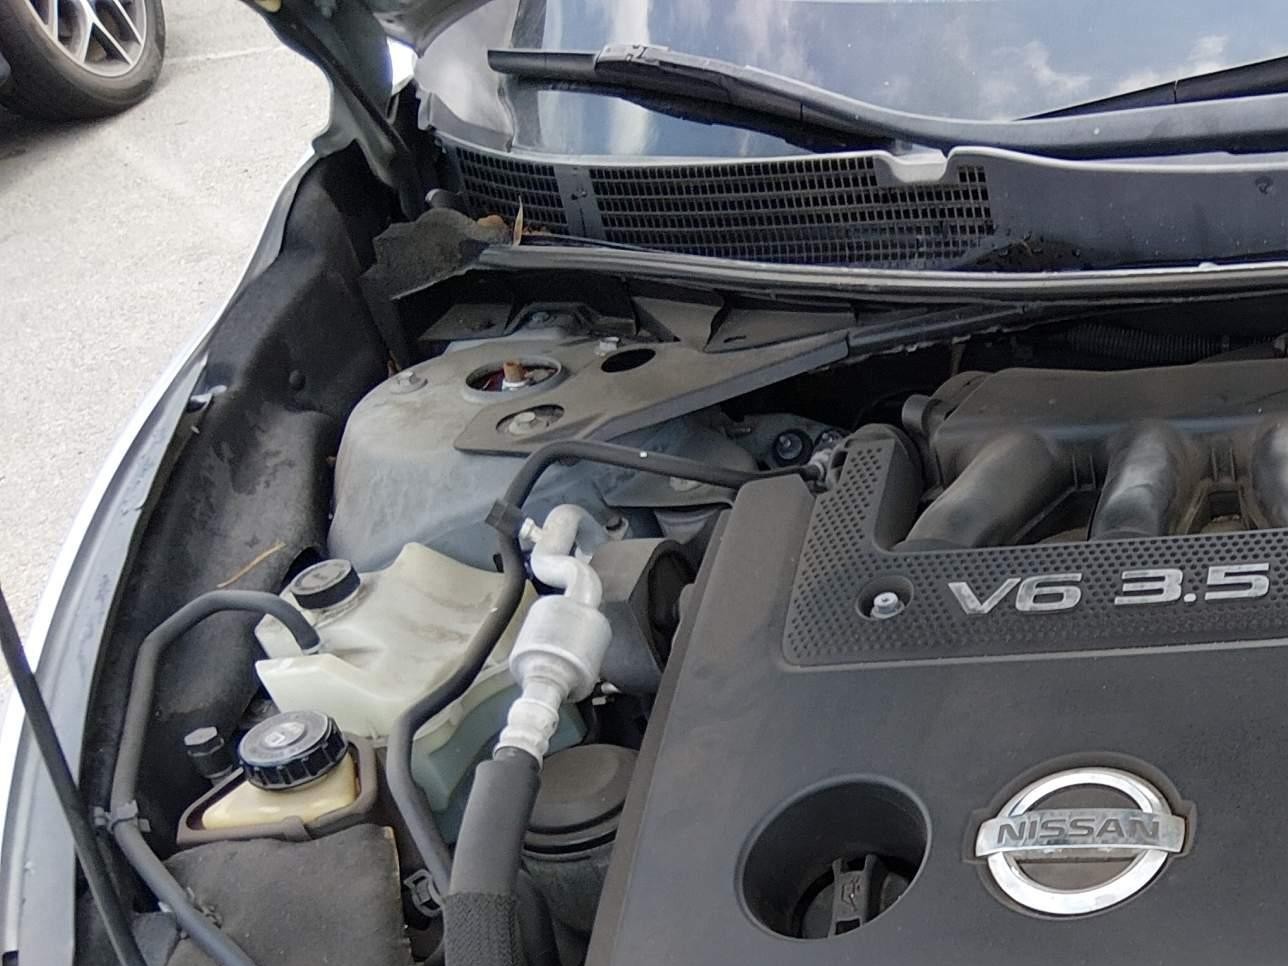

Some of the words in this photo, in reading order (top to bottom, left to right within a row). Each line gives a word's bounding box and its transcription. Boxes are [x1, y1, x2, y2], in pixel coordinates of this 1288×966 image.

[947, 572, 1083, 615] V6
[1113, 562, 1270, 606] 3.5
[996, 815, 1161, 844] NISSAN
